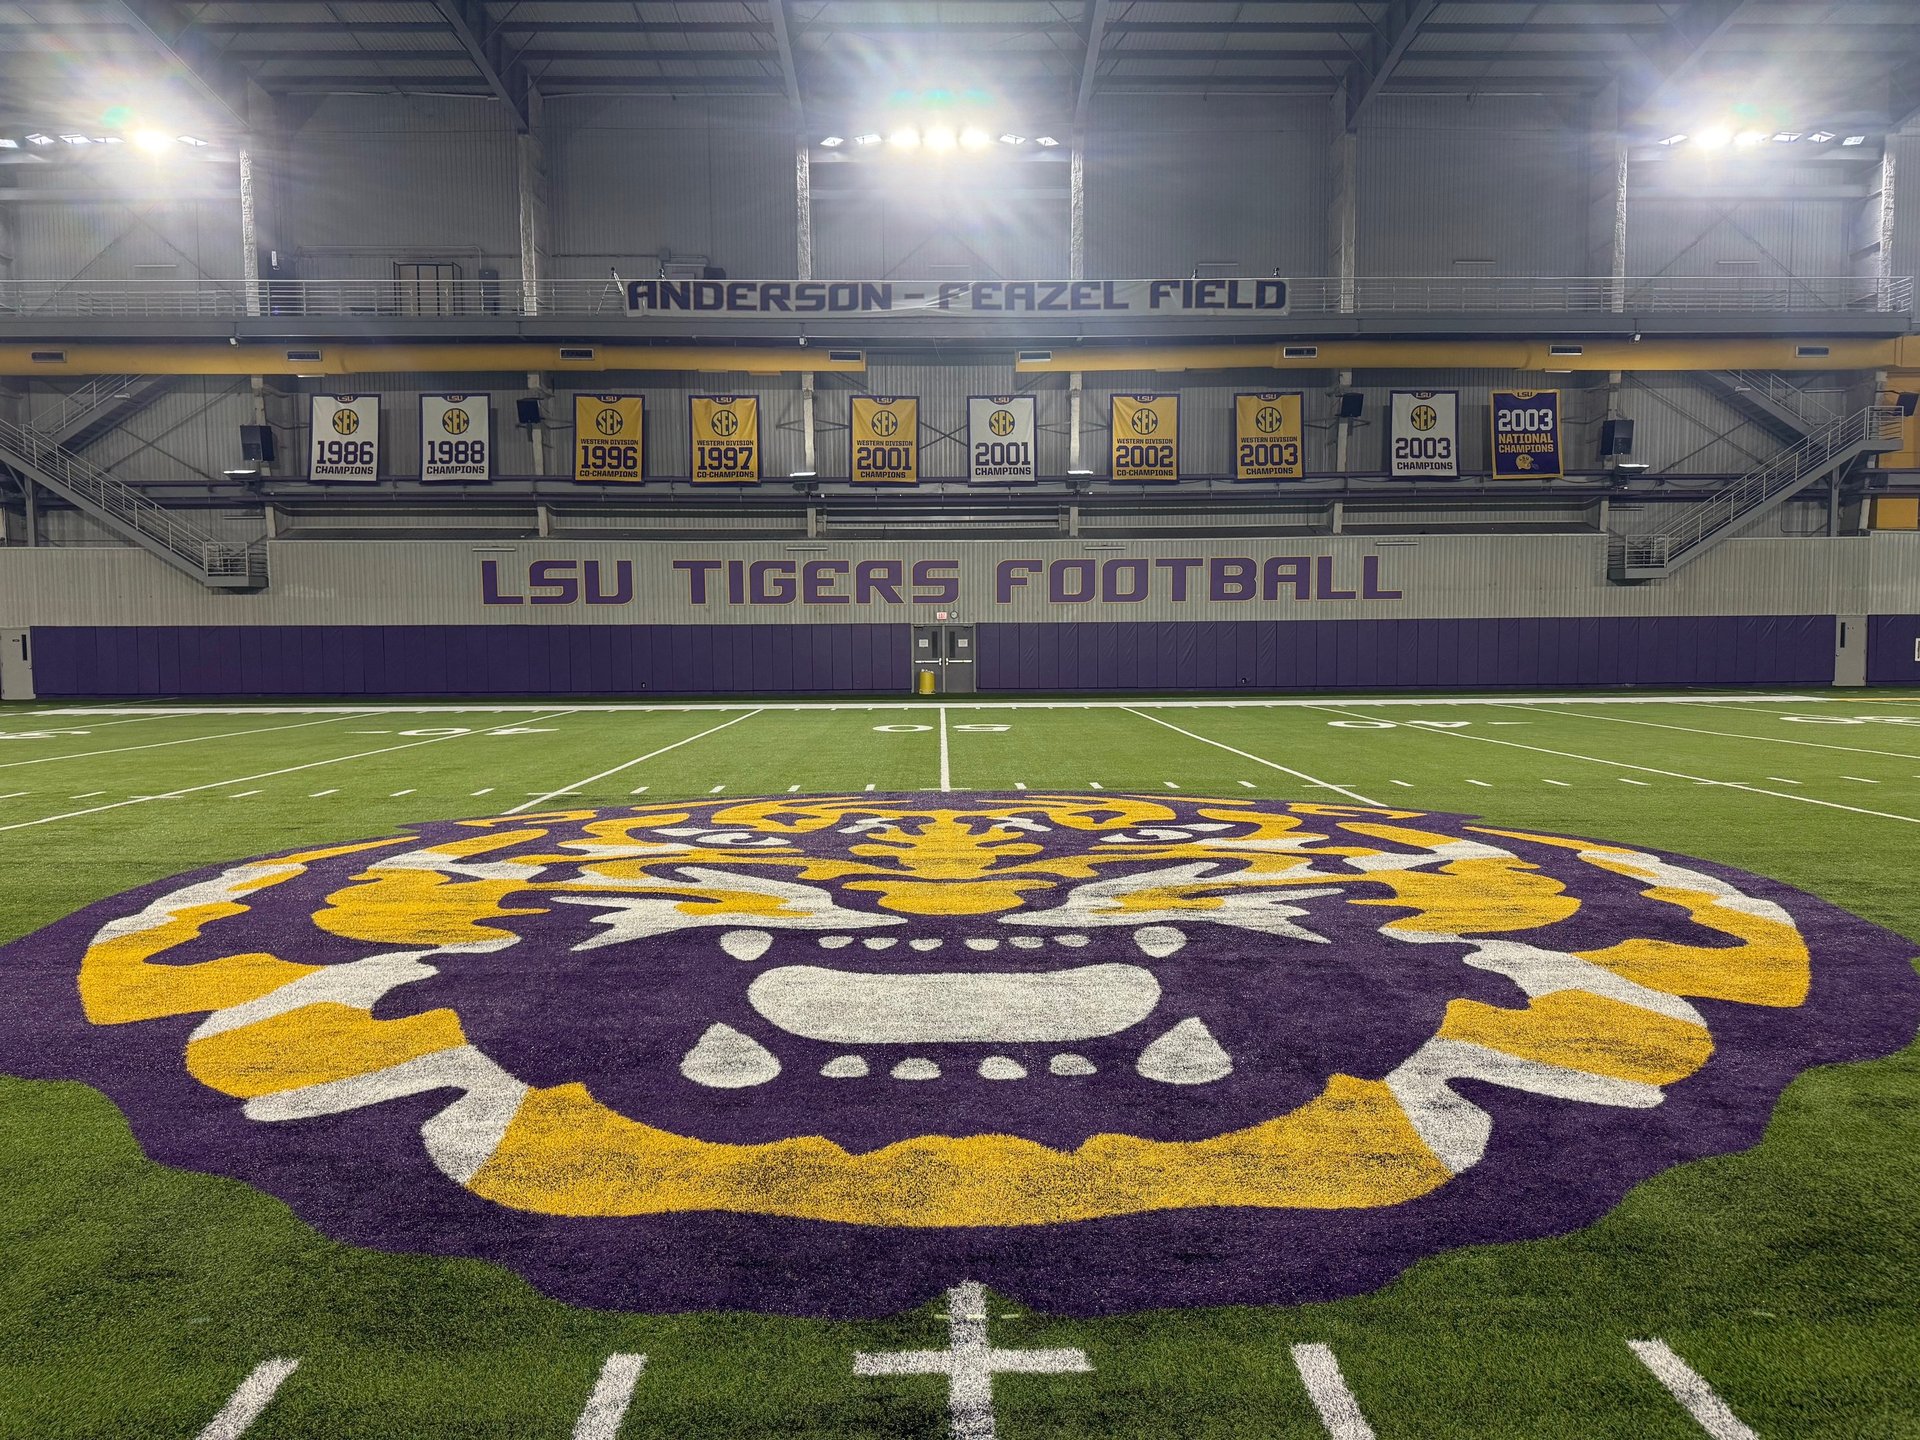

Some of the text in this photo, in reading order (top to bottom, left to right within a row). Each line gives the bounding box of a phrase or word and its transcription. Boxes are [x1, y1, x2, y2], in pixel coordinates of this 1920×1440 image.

[627, 281, 892, 311] ANDERSON
[1150, 280, 1286, 309] FIELD
[333, 409, 359, 435] SEC
[442, 408, 470, 435] SEC
[596, 409, 623, 435] SEC
[711, 410, 738, 436] SEC
[871, 410, 898, 437] SEC
[989, 410, 1015, 436] SEC
[1131, 408, 1158, 435] SEC
[1255, 406, 1282, 434] SEC
[1411, 405, 1437, 431] SEC
[1498, 409, 1553, 431] 2003
[1395, 437, 1451, 459] 2003
[1498, 433, 1554, 444] NATIONAL
[1498, 444, 1554, 453] CHAMPIONS
[317, 441, 374, 464] 1986
[428, 441, 485, 464] 1988
[581, 446, 638, 470] 1996
[698, 447, 753, 470] 1997
[857, 447, 912, 471] 2001
[975, 442, 1031, 466] 2001
[1116, 445, 1173, 468] 2002
[1240, 443, 1298, 467] 2003
[315, 466, 374, 475] CHAMPIONS
[427, 465, 485, 474] CHAMPIONS
[579, 470, 638, 478] CO-CHAMPIONS
[860, 471, 906, 479] CHAMPIONS
[975, 467, 1031, 476] CHAMPIONS
[1116, 469, 1173, 477] CO-CHAMPIONS
[1246, 467, 1293, 475] CHAMPIONS
[1397, 461, 1453, 470] CHAMPIONS
[481, 555, 1403, 606] LSU TIGERS FOOTBALL
